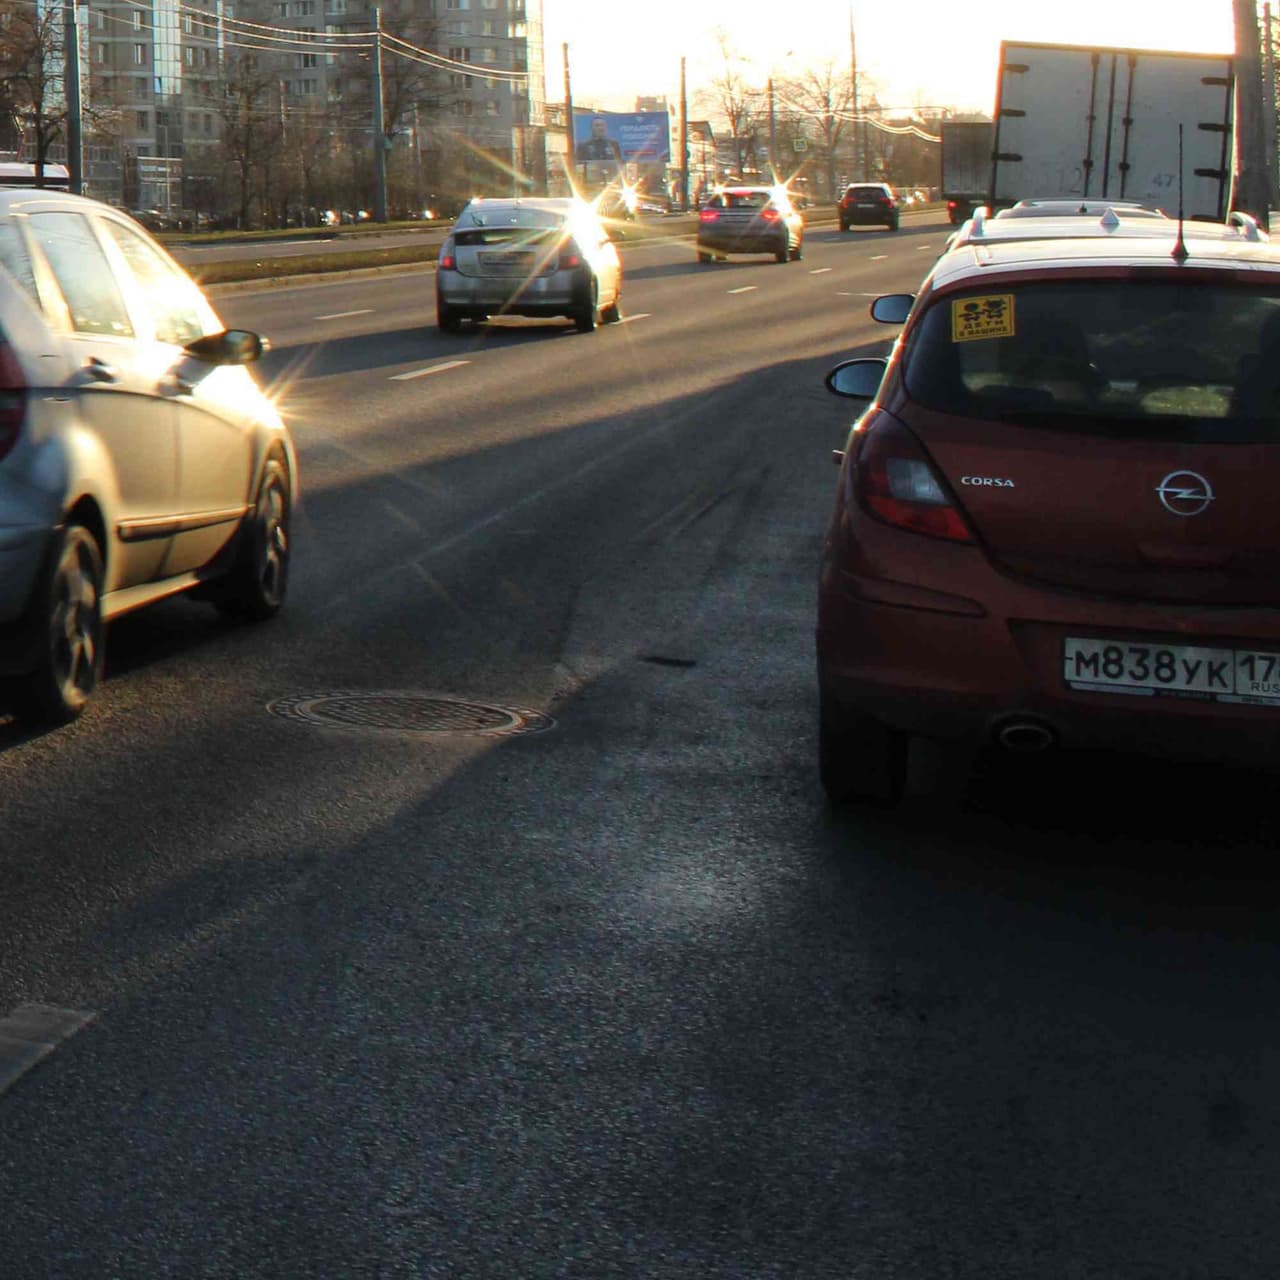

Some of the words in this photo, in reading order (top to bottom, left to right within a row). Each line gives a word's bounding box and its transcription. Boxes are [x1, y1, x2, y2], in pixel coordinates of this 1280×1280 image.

[961, 476, 1015, 488] CORSA
[1074, 646, 1229, 689] М838УК
[1240, 654, 1280, 683] 17
[1251, 681, 1280, 694] RUS
